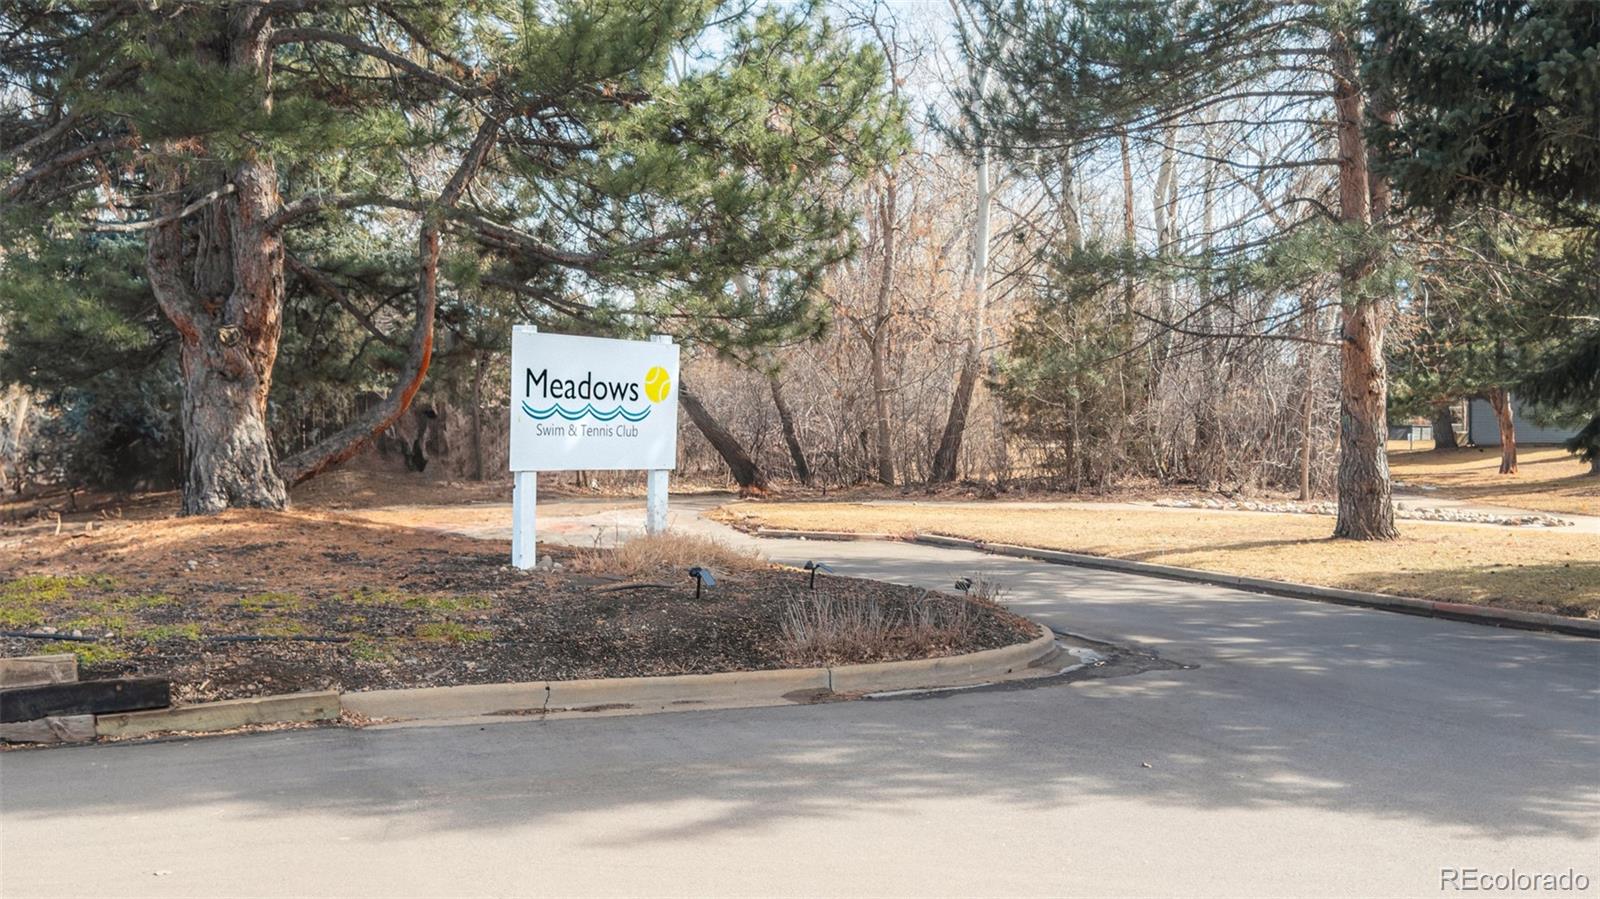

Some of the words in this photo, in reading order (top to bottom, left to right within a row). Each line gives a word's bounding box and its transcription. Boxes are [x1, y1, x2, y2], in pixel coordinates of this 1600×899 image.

[526, 368, 639, 401] Meadows
[536, 423, 564, 437] Swim
[568, 424, 577, 437] &
[581, 424, 613, 437] Tennis
[616, 424, 639, 437] Club
